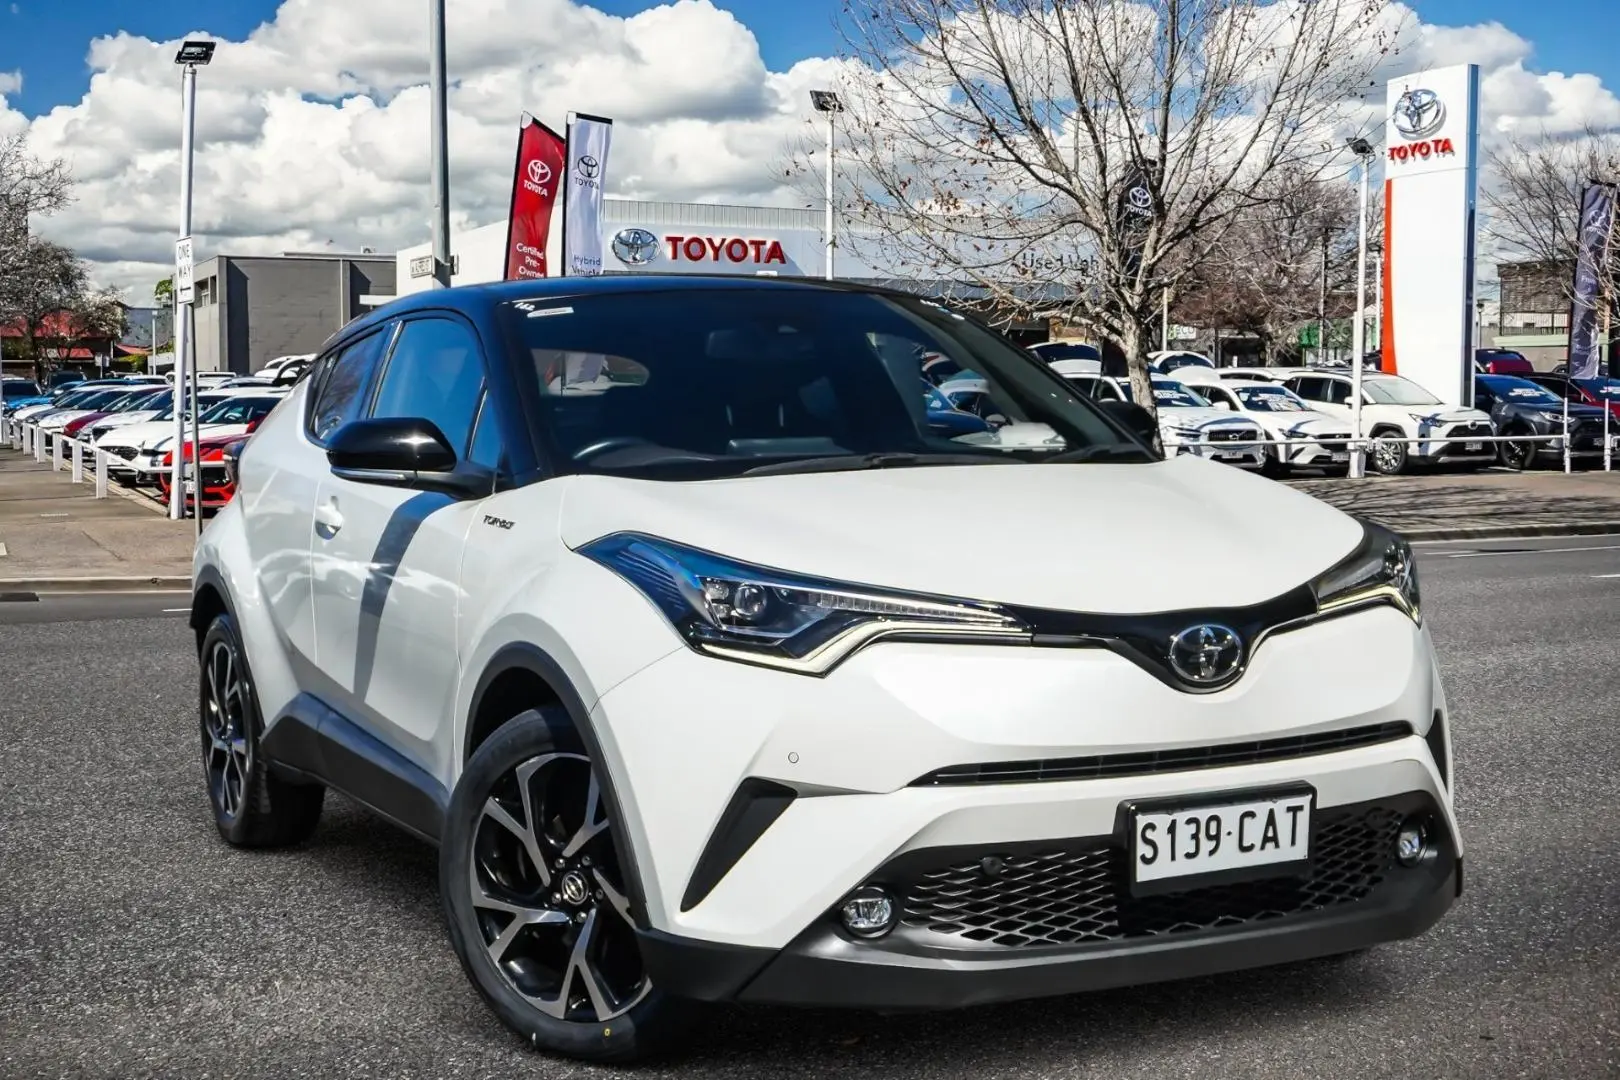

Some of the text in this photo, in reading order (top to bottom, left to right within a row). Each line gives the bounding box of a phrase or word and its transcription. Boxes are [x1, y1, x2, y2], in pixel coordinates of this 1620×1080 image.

[1388, 138, 1454, 161] TOYOTA
[523, 180, 548, 197] TOYOTA
[575, 177, 600, 190] TOYOTA
[1124, 203, 1152, 217] TOYOTA
[178, 243, 190, 260] ONE
[516, 242, 545, 260] Certified
[665, 236, 786, 265] TOYOTA
[525, 255, 541, 268] Pre-
[573, 255, 601, 266] Hybrid
[178, 264, 191, 279] WAY
